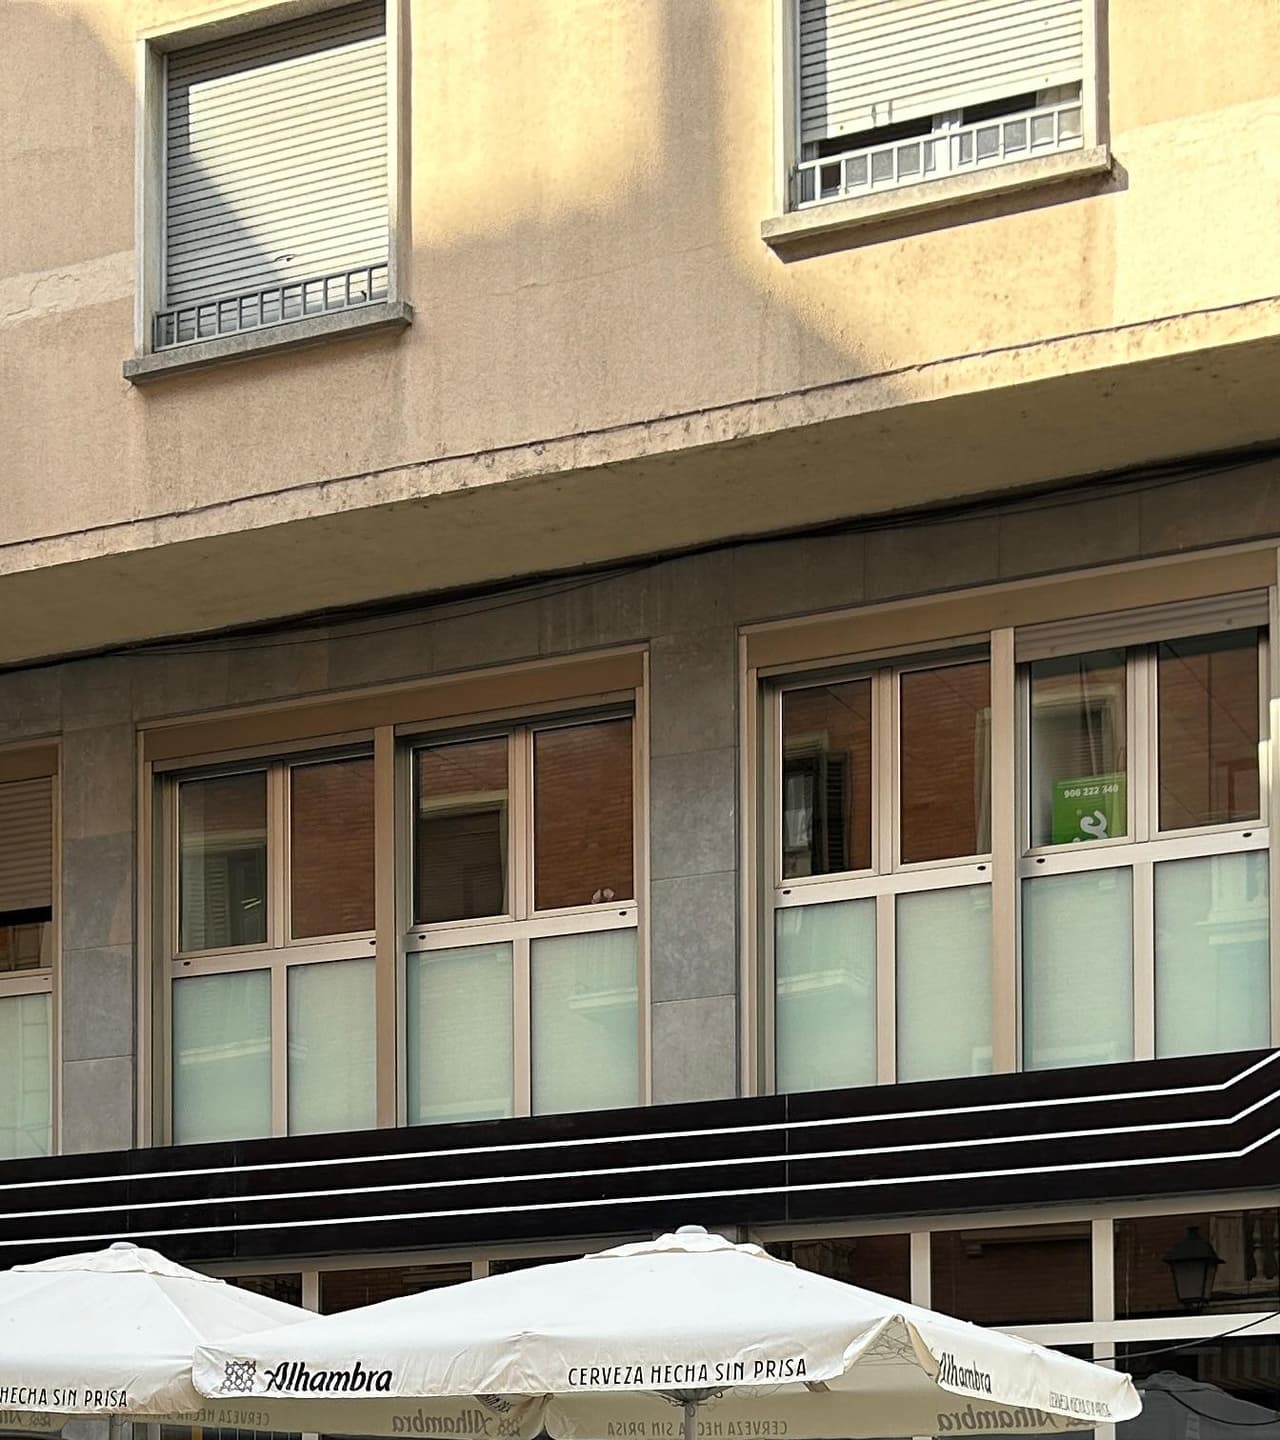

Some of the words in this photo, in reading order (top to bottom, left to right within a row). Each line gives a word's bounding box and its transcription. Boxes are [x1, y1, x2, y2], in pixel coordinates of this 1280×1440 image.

[263, 1361, 394, 1393] Alhambra
[567, 1366, 645, 1387] CERVEZA
[650, 1364, 708, 1385] HECHA
[715, 1361, 744, 1382] SIN
[753, 1359, 808, 1379] PRISA
[0, 1386, 48, 1406] HECHA
[53, 1387, 78, 1406] SIN
[84, 1388, 128, 1408] PRISA
